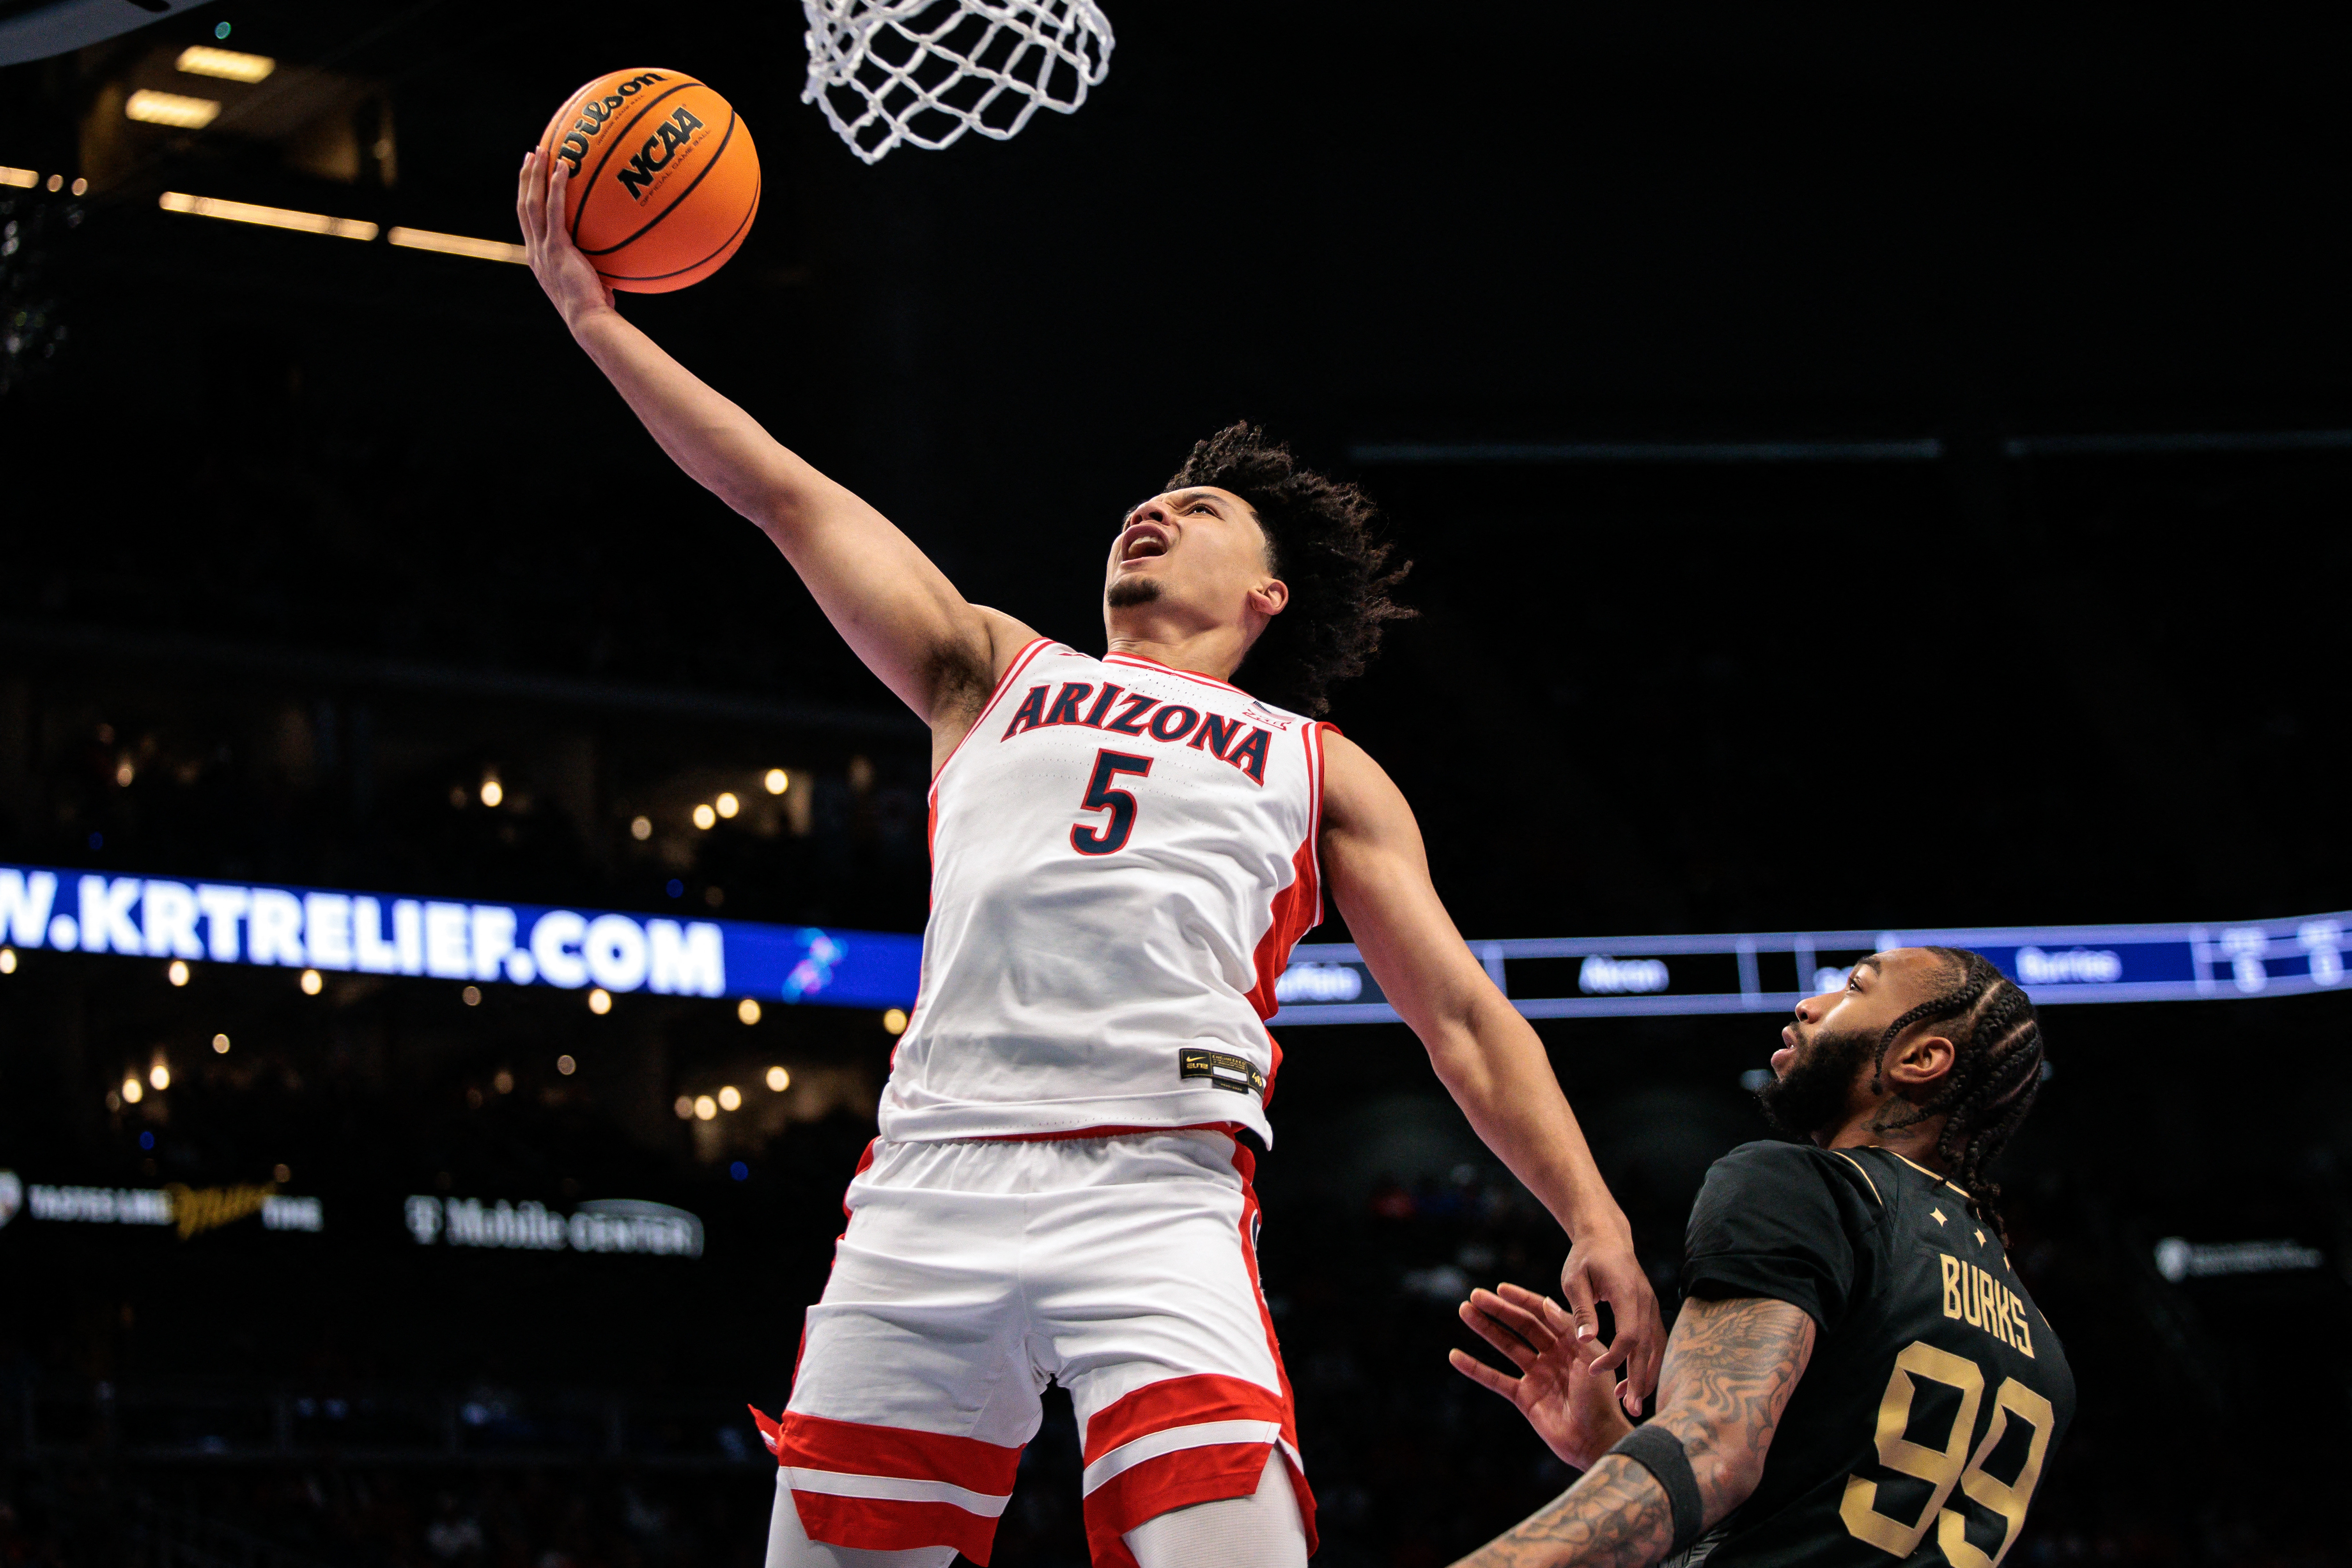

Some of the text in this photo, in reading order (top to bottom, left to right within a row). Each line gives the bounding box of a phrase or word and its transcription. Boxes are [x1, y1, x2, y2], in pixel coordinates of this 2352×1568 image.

[555, 73, 668, 178] Wilson
[617, 106, 705, 201] NCAA
[640, 129, 711, 207] OFFICIAL GAME BALL
[1001, 681, 1272, 787] ARIZONA
[1070, 748, 1154, 856] 5
[1940, 1253, 2035, 1359] BURKS
[1839, 1340, 2054, 1568] 99
